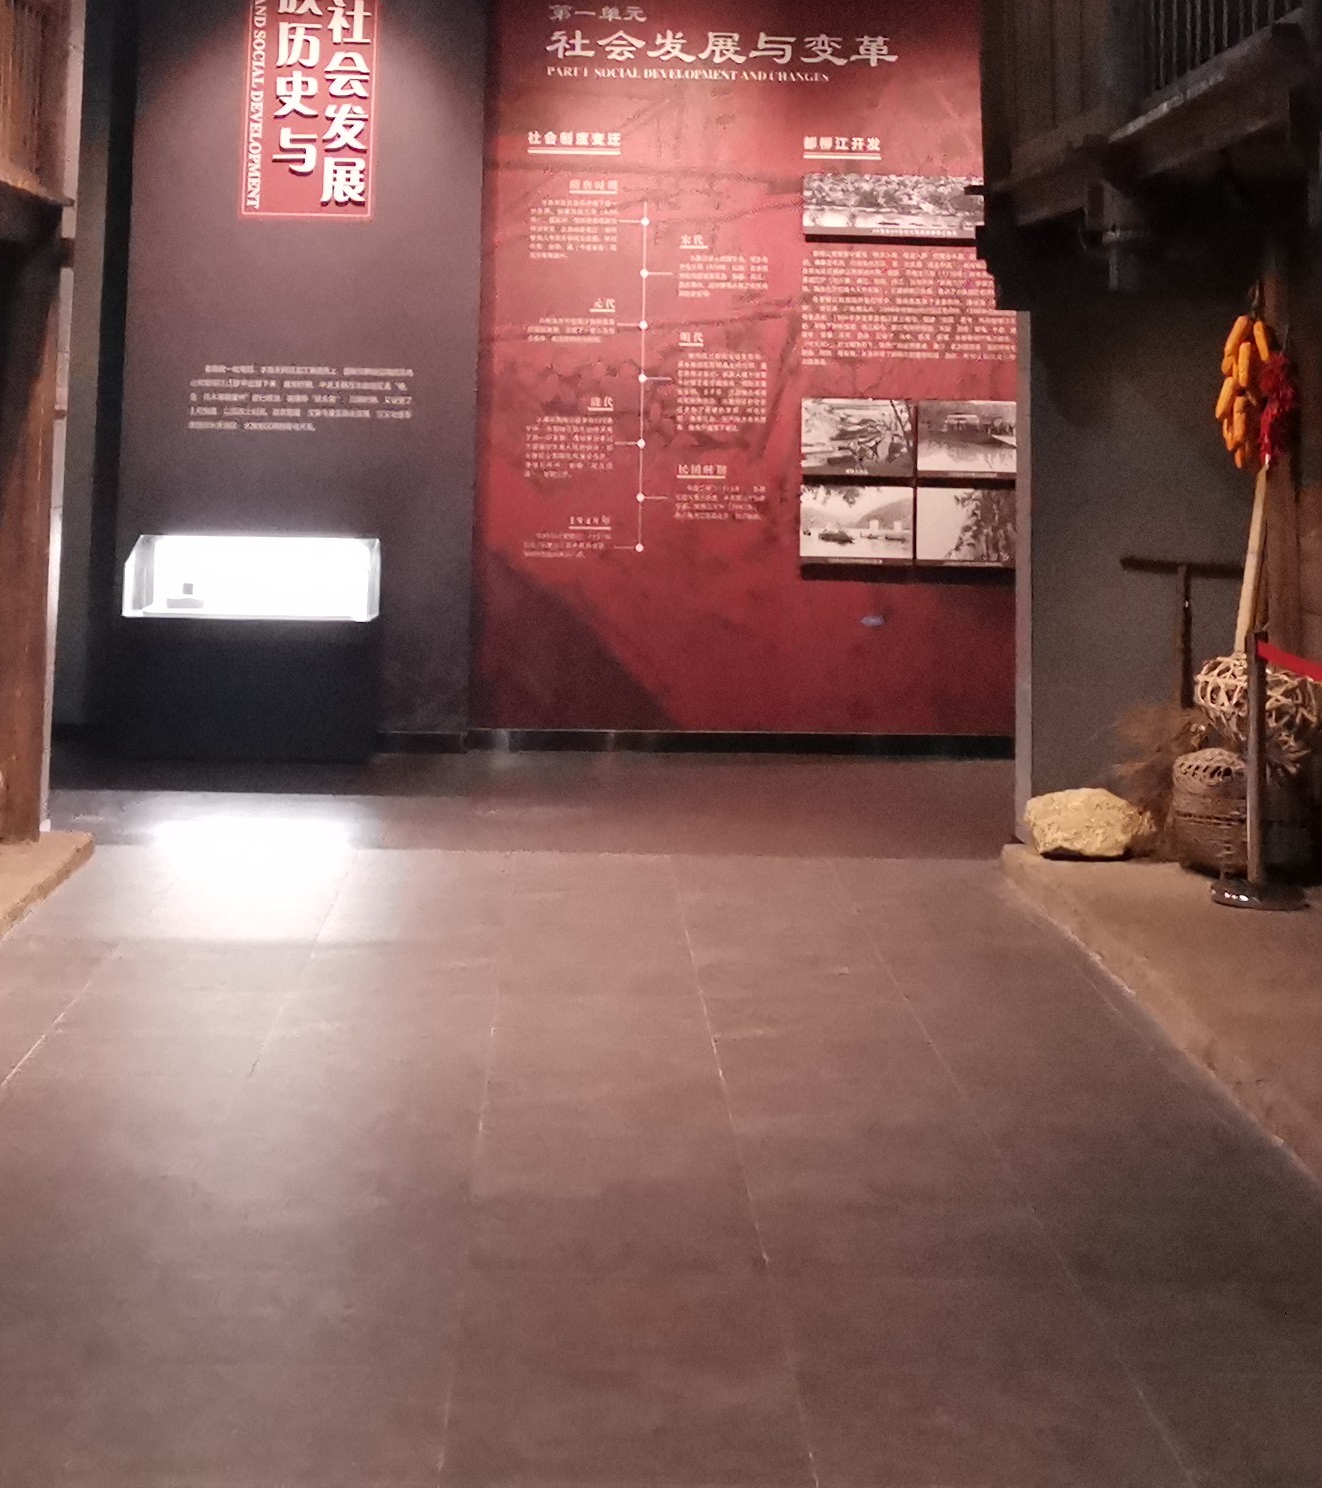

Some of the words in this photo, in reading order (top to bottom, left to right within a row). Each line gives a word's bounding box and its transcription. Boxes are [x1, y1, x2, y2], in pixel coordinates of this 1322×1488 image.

[548, 4, 647, 22] 第一单元
[251, 30, 267, 88] SOCIAL
[546, 29, 899, 67] 社会发展与变革
[594, 67, 641, 79] SOCIAL
[643, 68, 738, 80] DEVELOPMENT
[740, 70, 767, 81] AND
[769, 70, 829, 82] CHANGES
[246, 90, 264, 210] DEVELOPMENT
